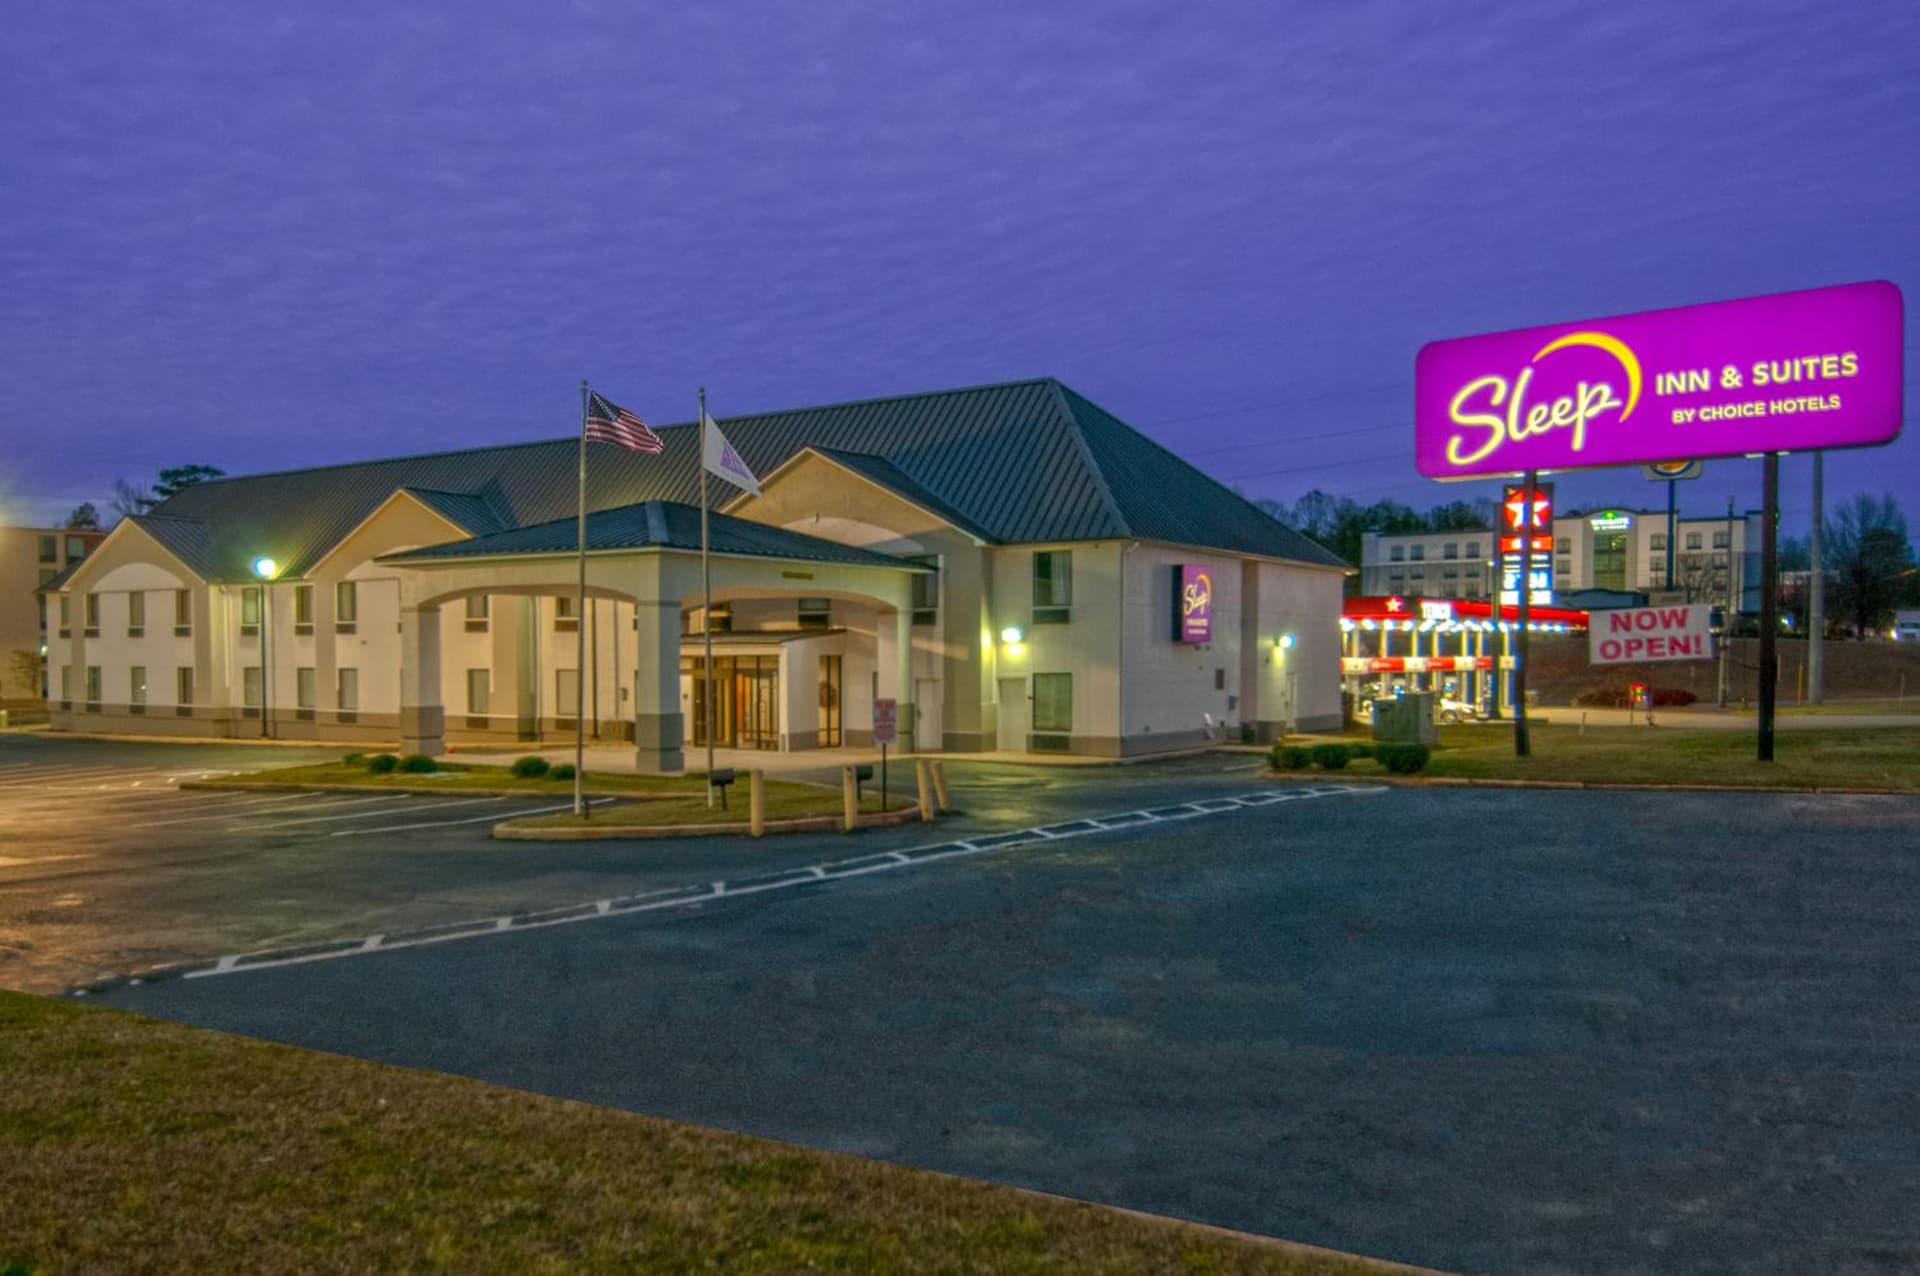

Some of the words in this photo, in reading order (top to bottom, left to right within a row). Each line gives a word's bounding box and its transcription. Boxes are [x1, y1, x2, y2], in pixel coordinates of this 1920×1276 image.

[1655, 368, 1711, 396] INN
[1720, 364, 1743, 389] &
[1752, 353, 1859, 386] SUITES
[1446, 366, 1622, 466] Sleep
[1672, 408, 1696, 425] BY
[1698, 401, 1766, 422] CHOICE
[1769, 394, 1841, 415] HOTELS
[1610, 607, 1690, 632] NOW
[1599, 633, 1702, 661] OPEN!
